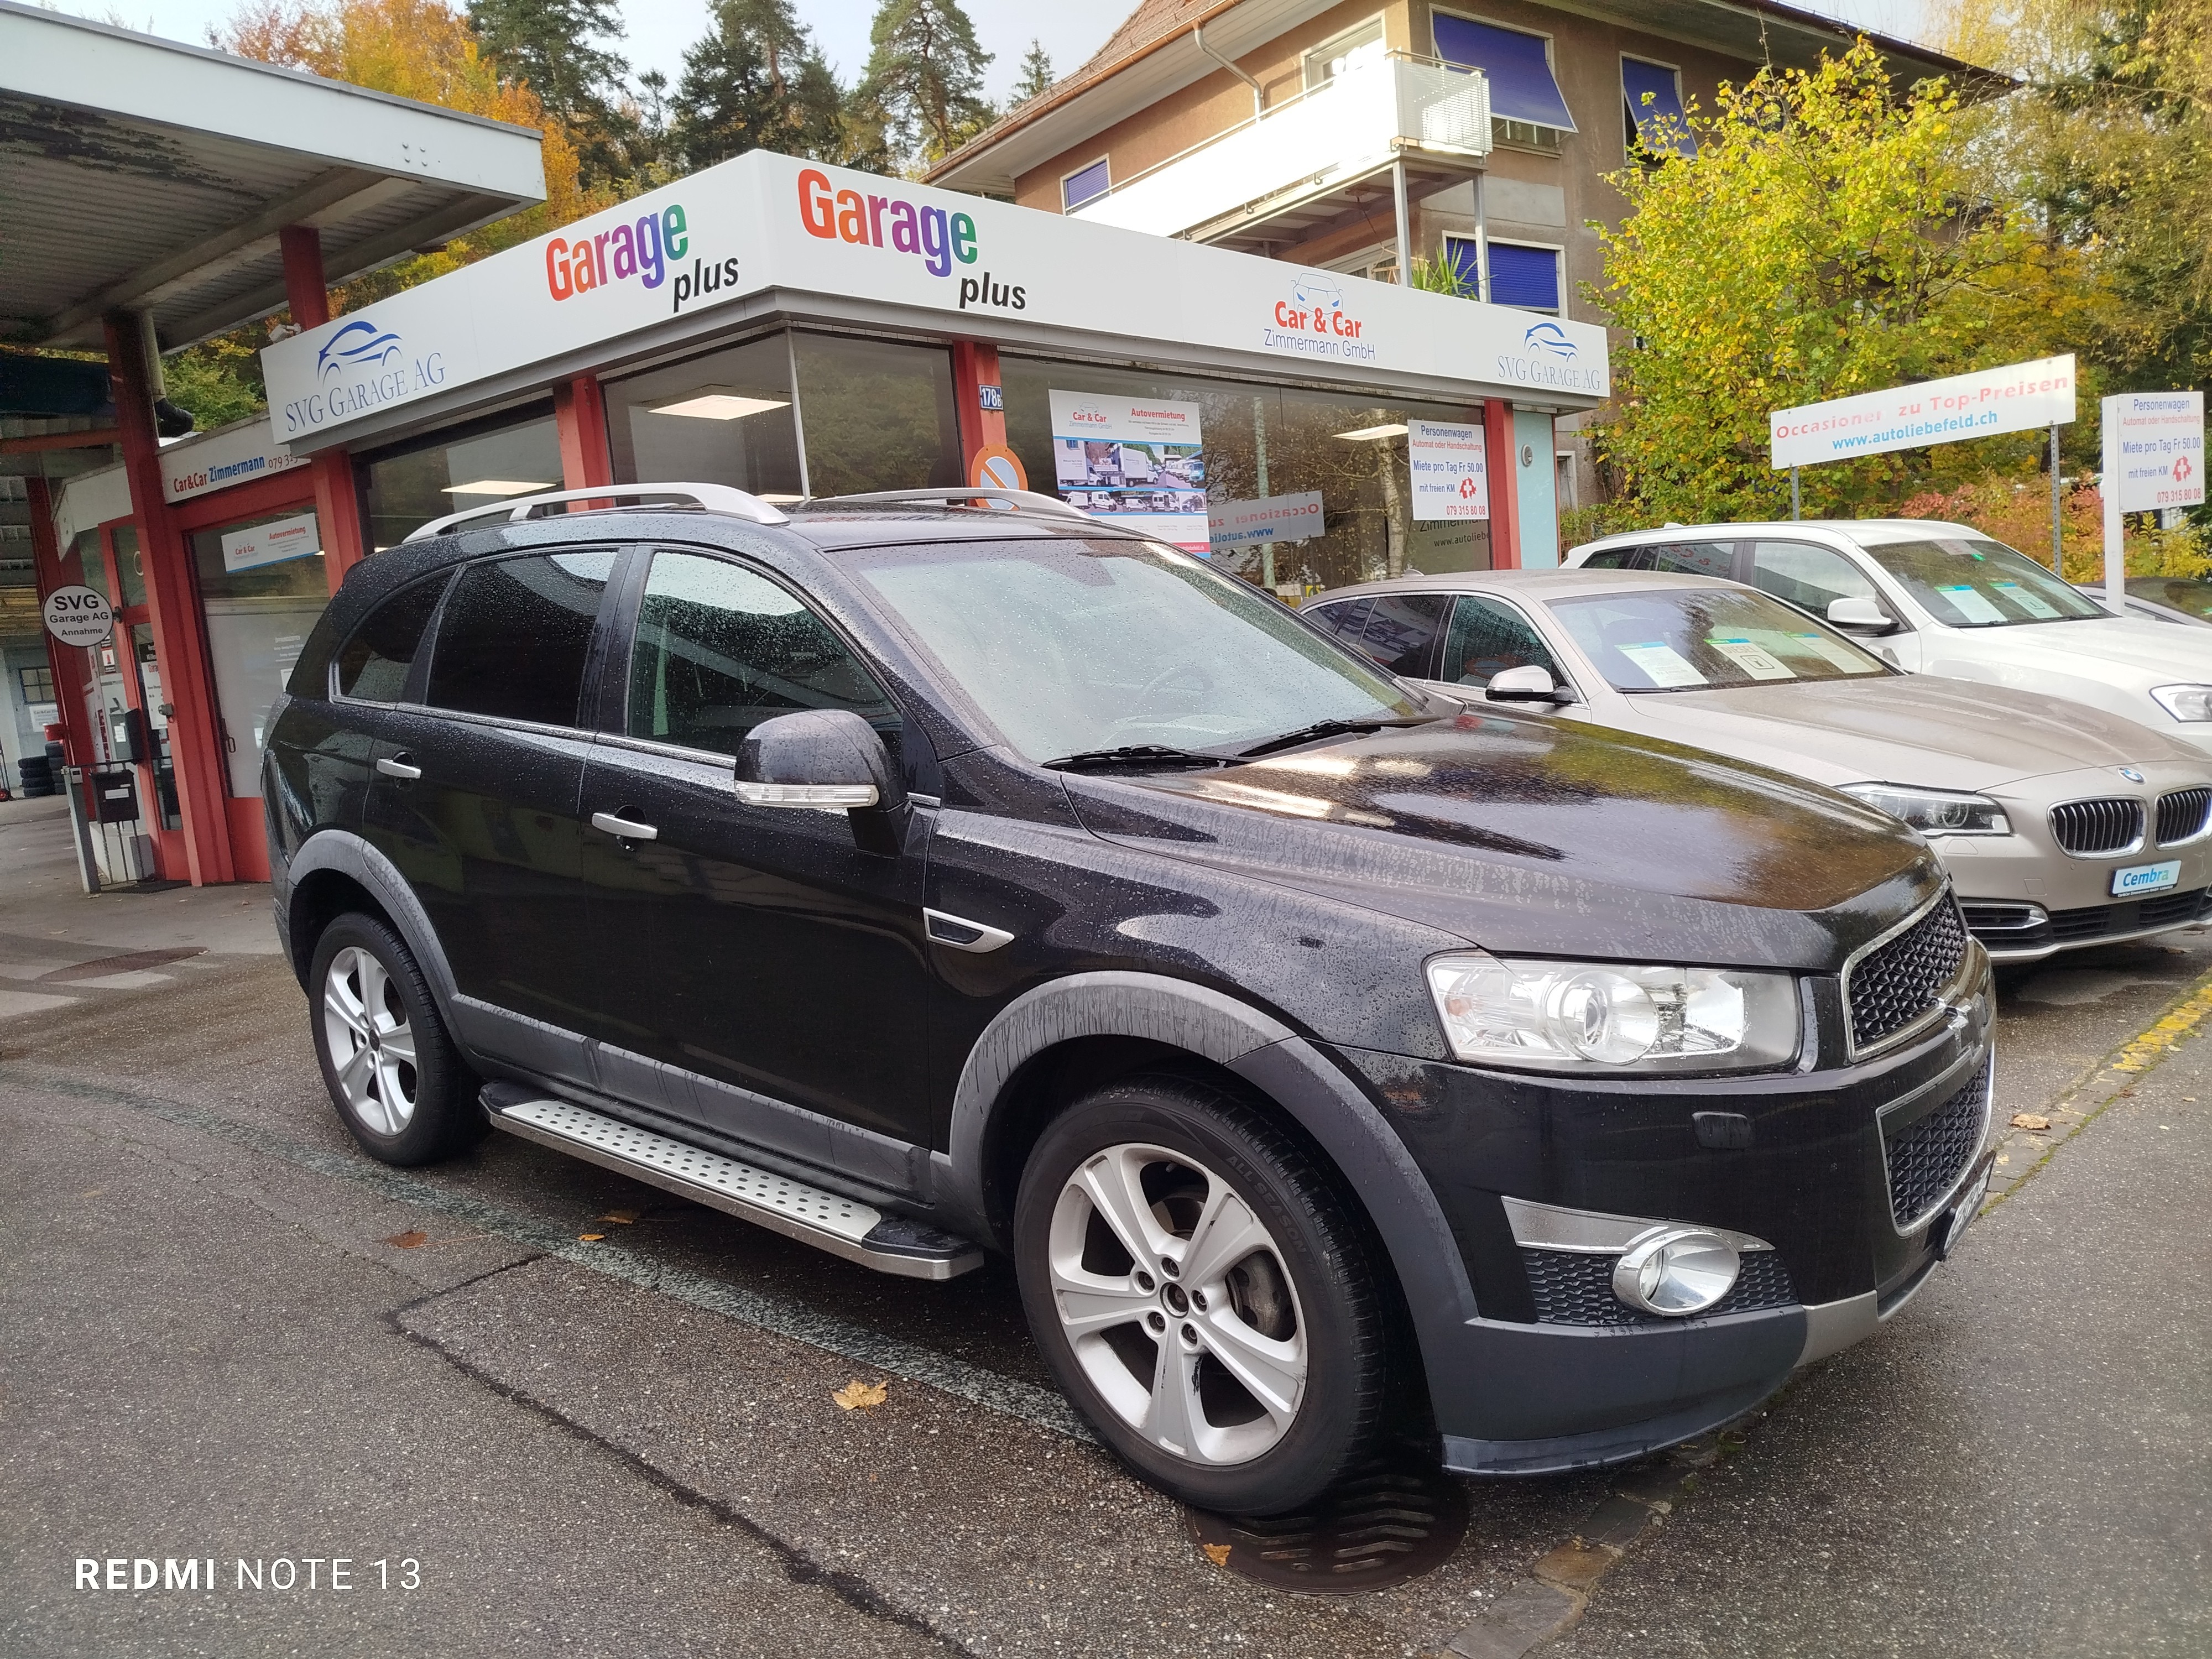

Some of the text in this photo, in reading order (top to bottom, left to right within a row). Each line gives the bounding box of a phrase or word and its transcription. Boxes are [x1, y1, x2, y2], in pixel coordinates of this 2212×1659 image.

[797, 169, 978, 278] Garage
[545, 204, 688, 302] Garage
[672, 258, 739, 313] plus
[960, 272, 1027, 310] plus
[1275, 301, 1362, 338] Car & Car
[1264, 328, 1376, 360] Zimmermann GmbH
[1498, 356, 1600, 390] SVG GARAGE AG
[286, 352, 445, 432] SVG GARAGE AG
[982, 387, 1002, 407] 178B
[1898, 401, 1921, 417] zu
[1929, 377, 2068, 411] Top-Preisen
[2134, 399, 2190, 412] Personenwagen
[1073, 411, 1107, 422] Car & Car
[1131, 408, 1185, 421] Autovermietung
[2123, 416, 2146, 426] Automat
[2162, 415, 2200, 425] Handschaltung
[1421, 425, 1472, 440] Personenwagen
[1833, 411, 1997, 450] www.autoliebefeld.ch
[1412, 439, 1433, 448] Automat
[1447, 442, 1482, 452] Handschaltung
[2123, 437, 2200, 455] Miete pro Tag Fr 50.00
[174, 472, 207, 493] Car&Car
[208, 456, 265, 482] Zimmermann
[268, 456, 282, 468] 079
[1413, 460, 1483, 474] Miete pro Tag Fr 50.00
[2128, 466, 2168, 478] mit freien KM
[1420, 483, 1455, 492] mit freien KM
[2157, 488, 2201, 503] 079 315 80 08
[1447, 505, 1485, 515] 079 315 80 08
[269, 526, 306, 540] Autovermietung
[54, 594, 99, 611] SVG
[50, 612, 108, 623] Garage AG
[61, 628, 103, 637] Annahme
[2123, 868, 2169, 886] Cembra
[1225, 1155, 1307, 1253] ALL SEASON
